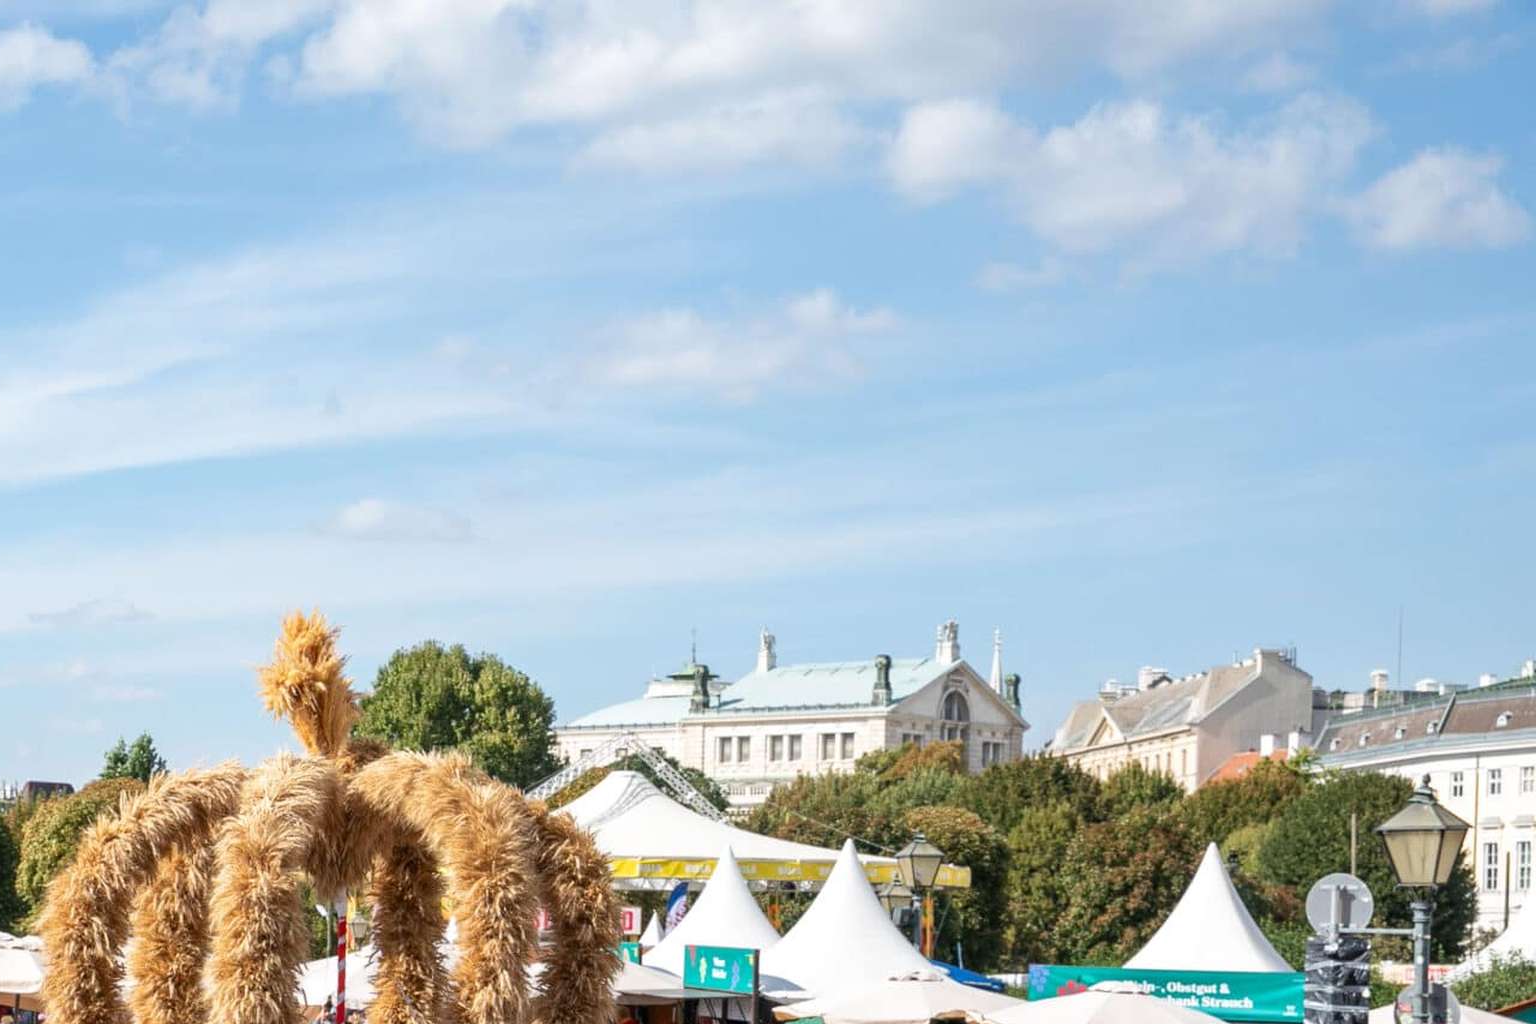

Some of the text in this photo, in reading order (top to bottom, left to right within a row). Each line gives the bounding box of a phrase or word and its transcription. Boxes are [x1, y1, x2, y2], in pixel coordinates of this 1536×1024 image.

[1166, 981, 1217, 995] Obstgut
[1219, 982, 1231, 994] &
[1201, 996, 1254, 1009] Strauch
